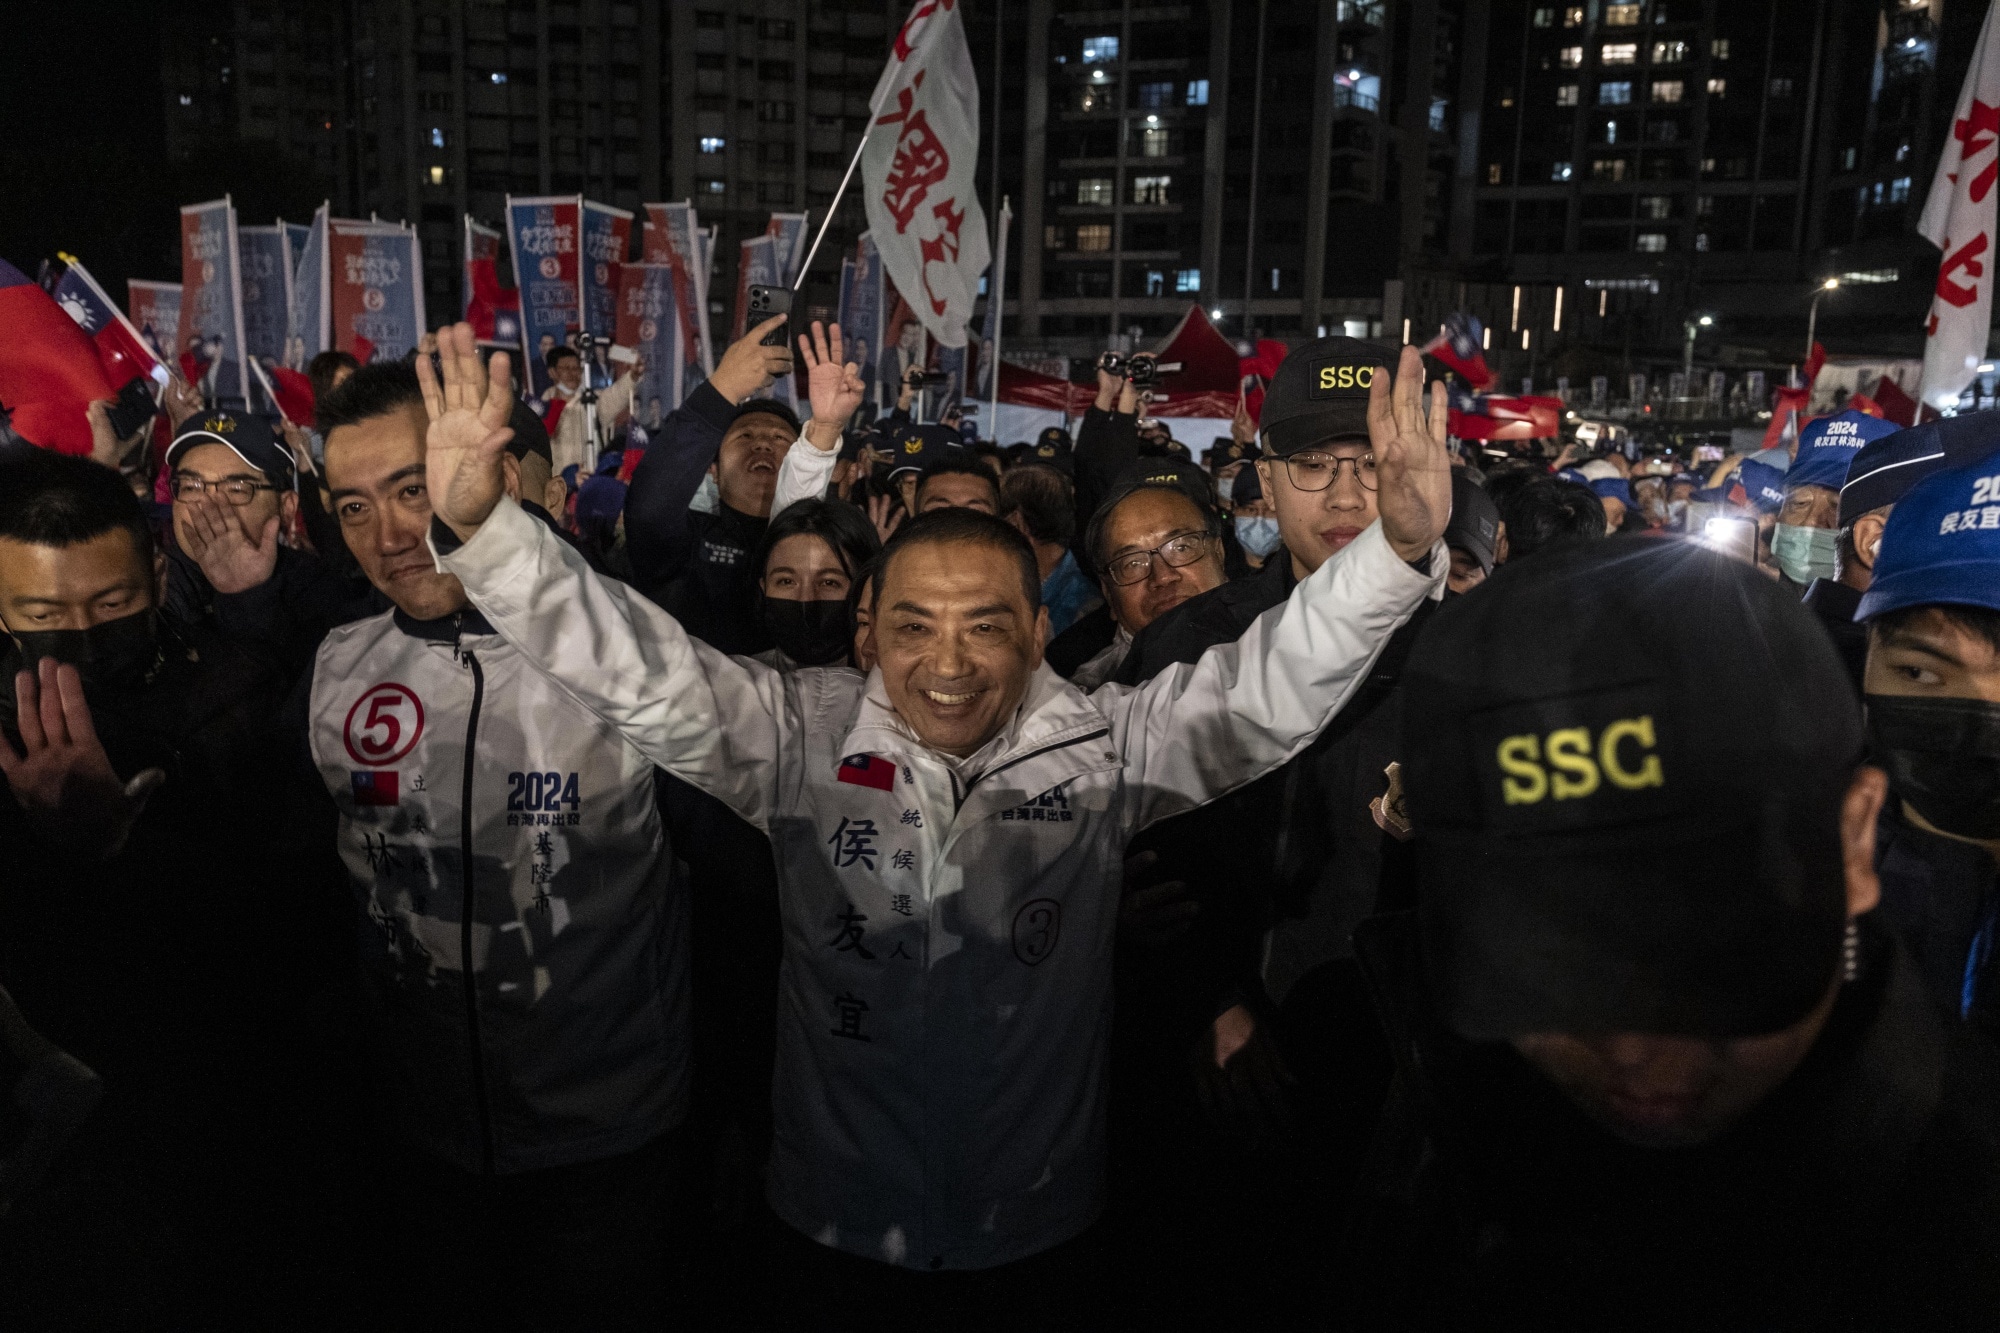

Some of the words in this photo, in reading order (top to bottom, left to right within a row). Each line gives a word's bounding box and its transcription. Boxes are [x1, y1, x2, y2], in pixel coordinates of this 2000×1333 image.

[1319, 366, 1374, 389] SSC
[1826, 421, 1858, 436] 2024
[1939, 505, 2000, 535] 侯友宜
[1496, 714, 1664, 806] SSC
[507, 772, 581, 812] 2024
[507, 813, 581, 827] 台灣再出發
[1002, 808, 1074, 822] 台灣再出發
[530, 831, 555, 914] 基隆市
[828, 816, 879, 1043] 侯友宜
